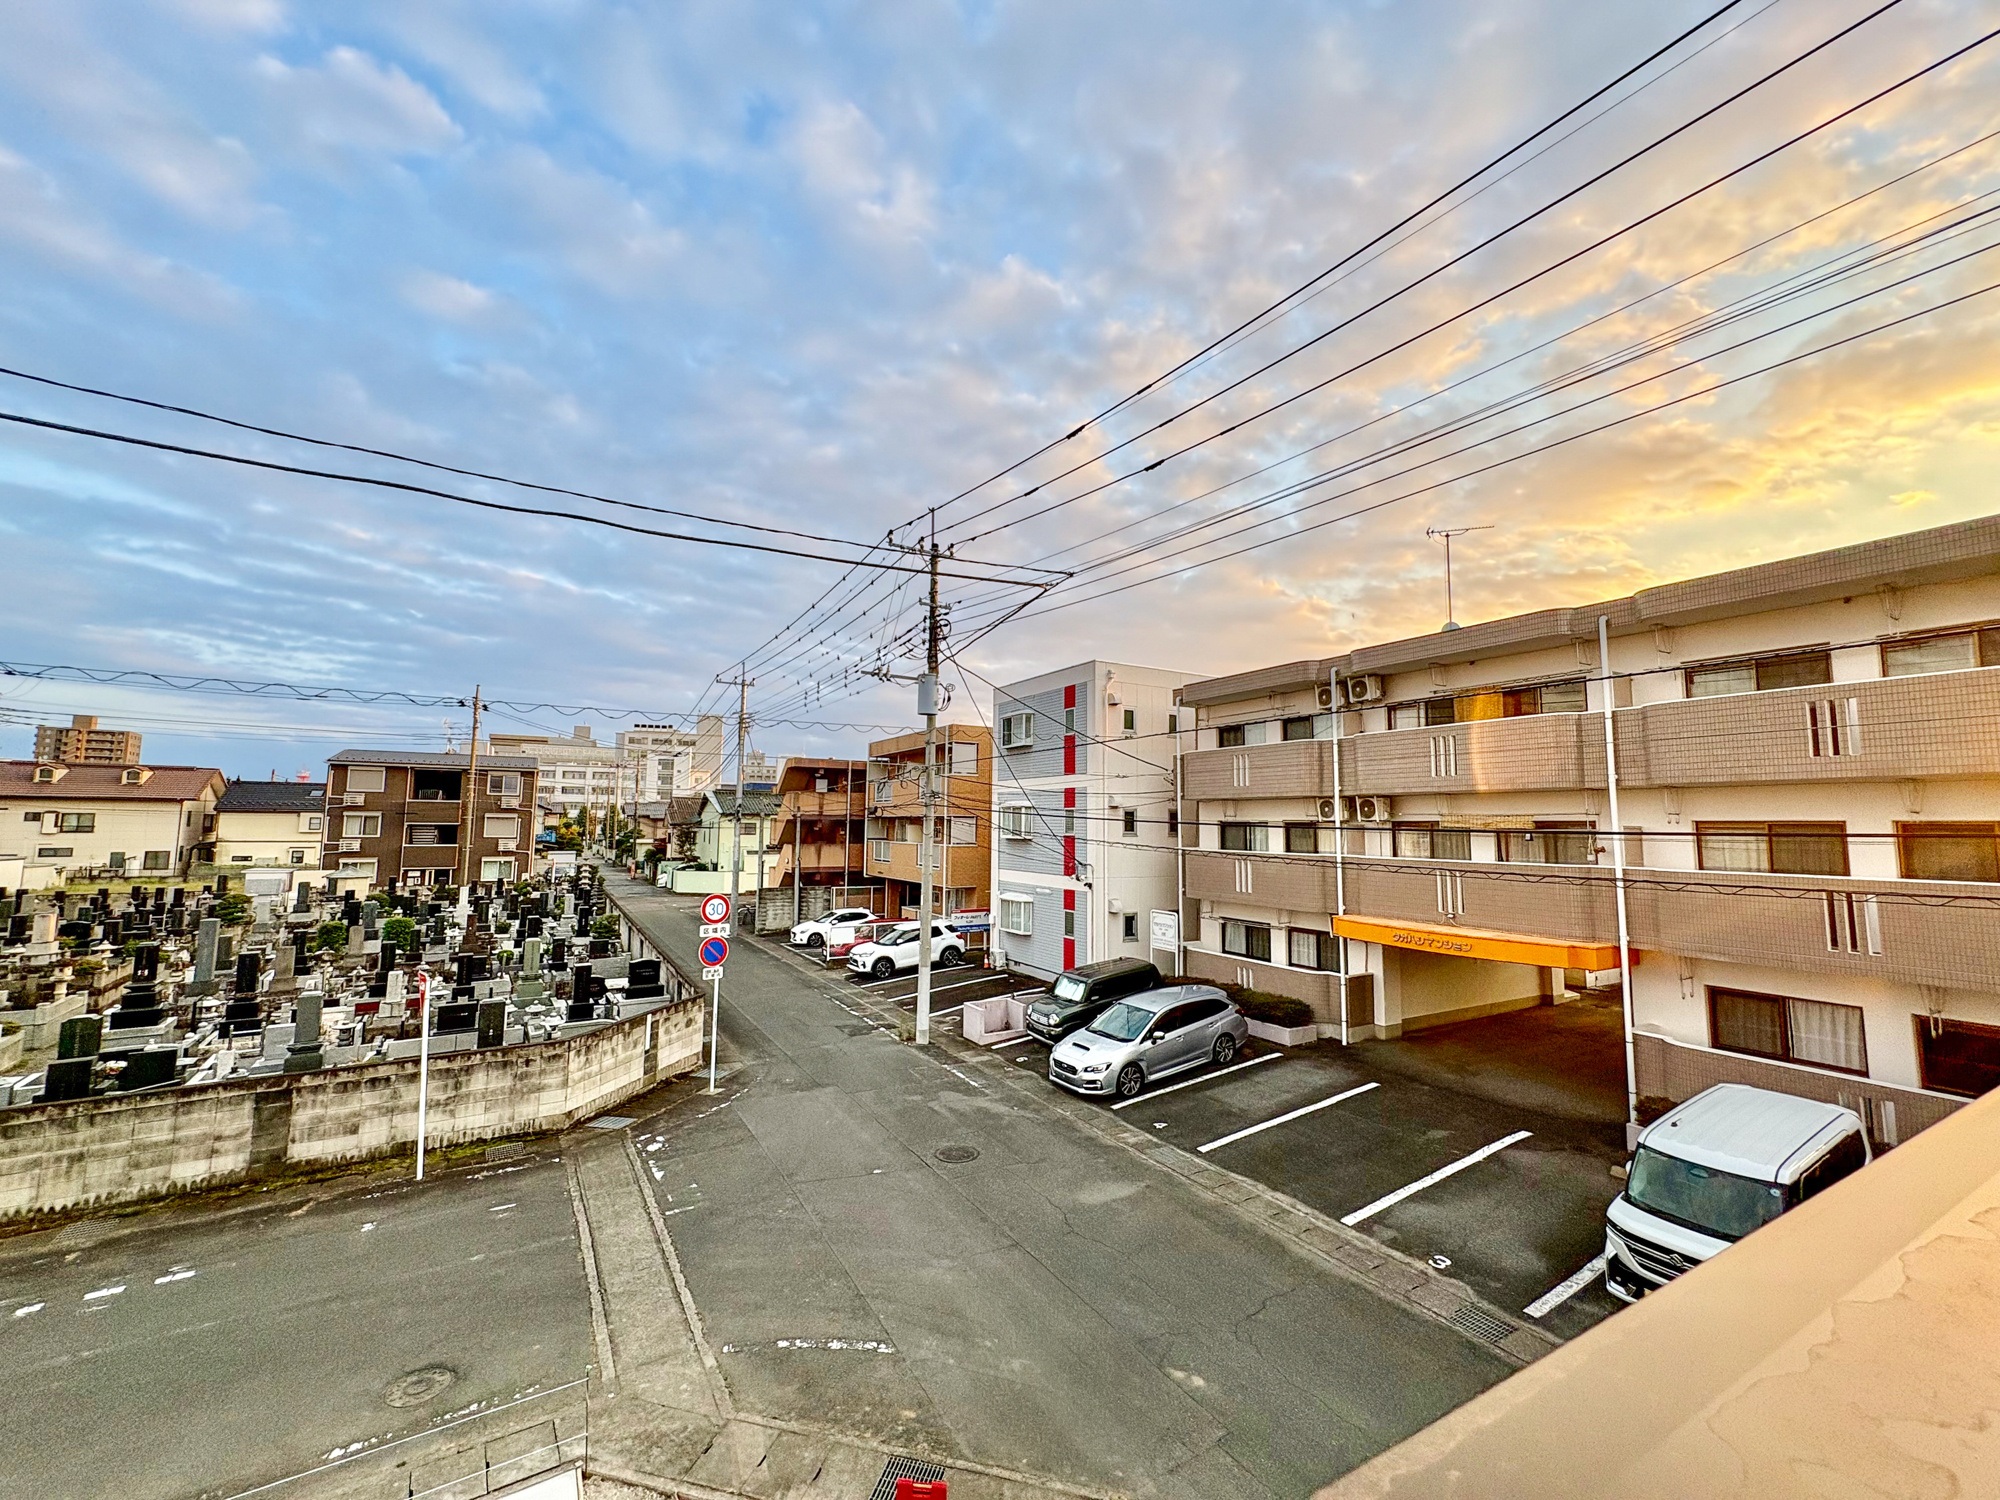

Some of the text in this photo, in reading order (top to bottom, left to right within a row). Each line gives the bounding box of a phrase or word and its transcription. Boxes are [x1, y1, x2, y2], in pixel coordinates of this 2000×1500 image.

[708, 902, 724, 916] 30
[703, 926, 727, 935] 区域内
[1427, 1254, 1453, 1270] 3
